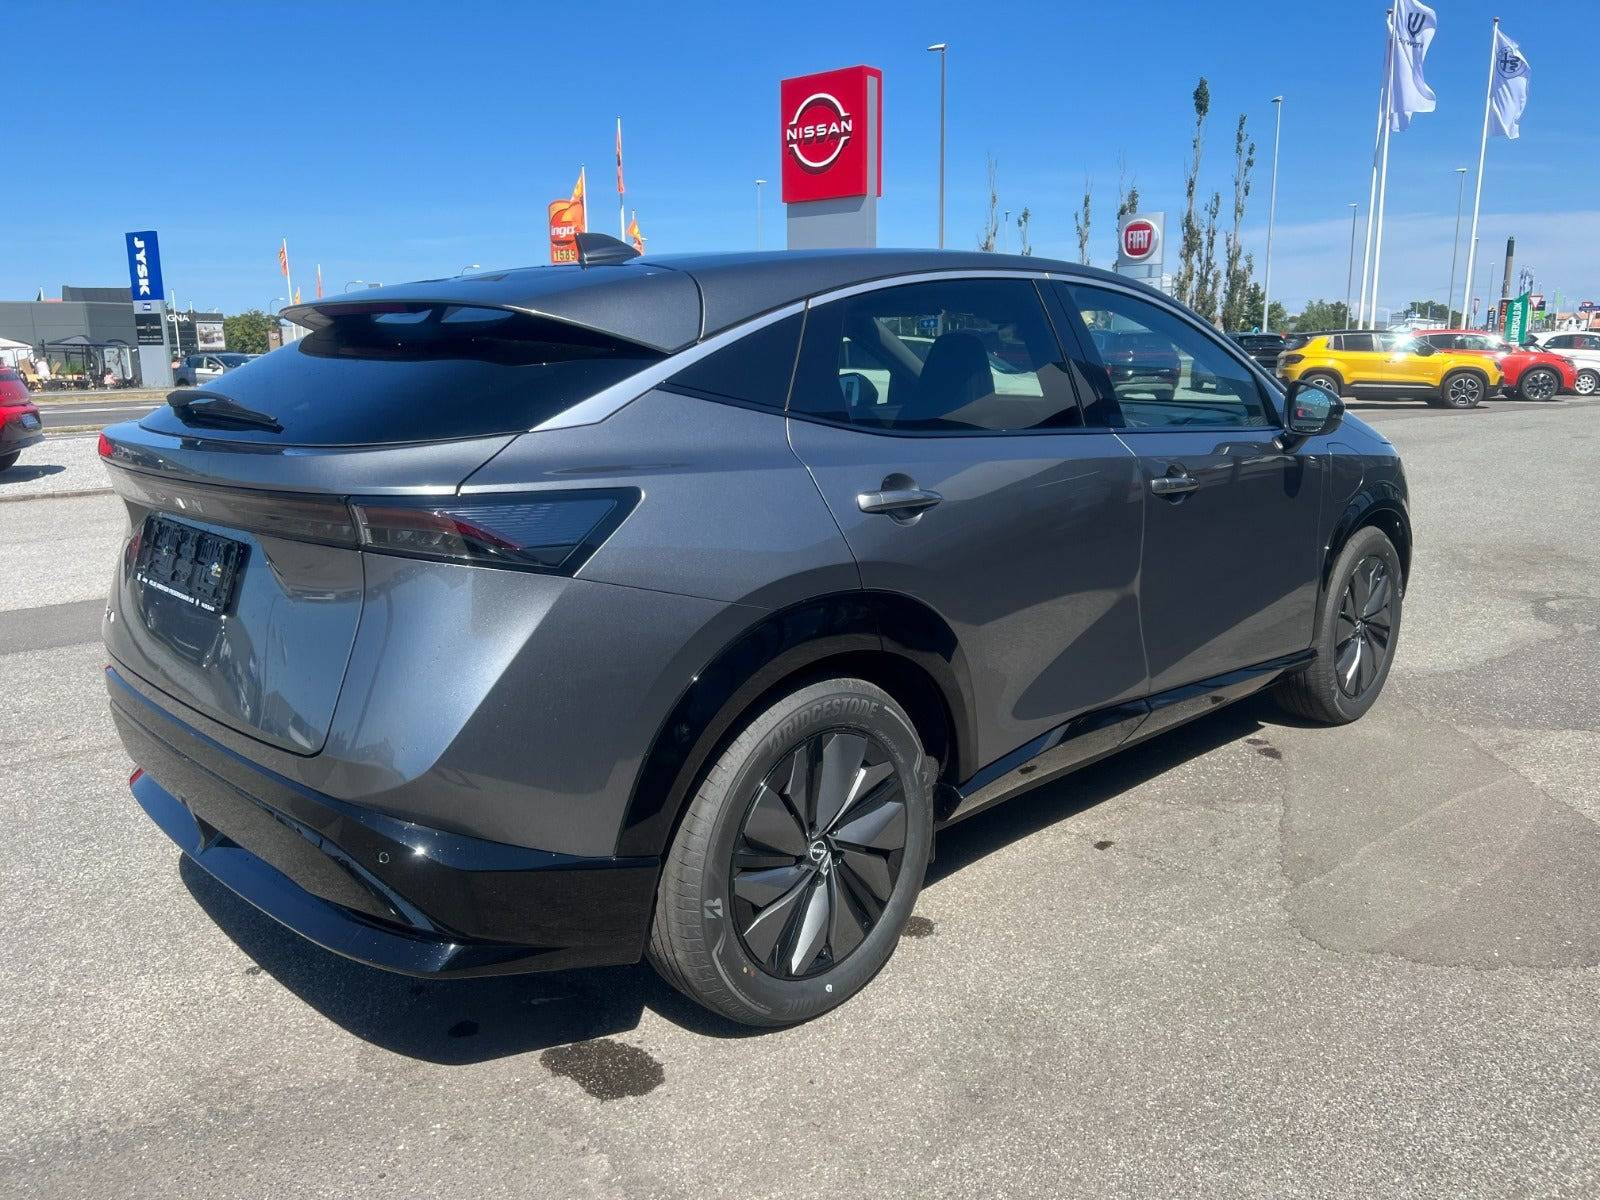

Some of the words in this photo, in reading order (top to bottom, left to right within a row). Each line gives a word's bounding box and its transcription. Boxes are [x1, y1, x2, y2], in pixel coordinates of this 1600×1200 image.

[786, 119, 852, 141] NISSAN
[1127, 230, 1150, 249] FIAT
[134, 237, 150, 296] JYSK
